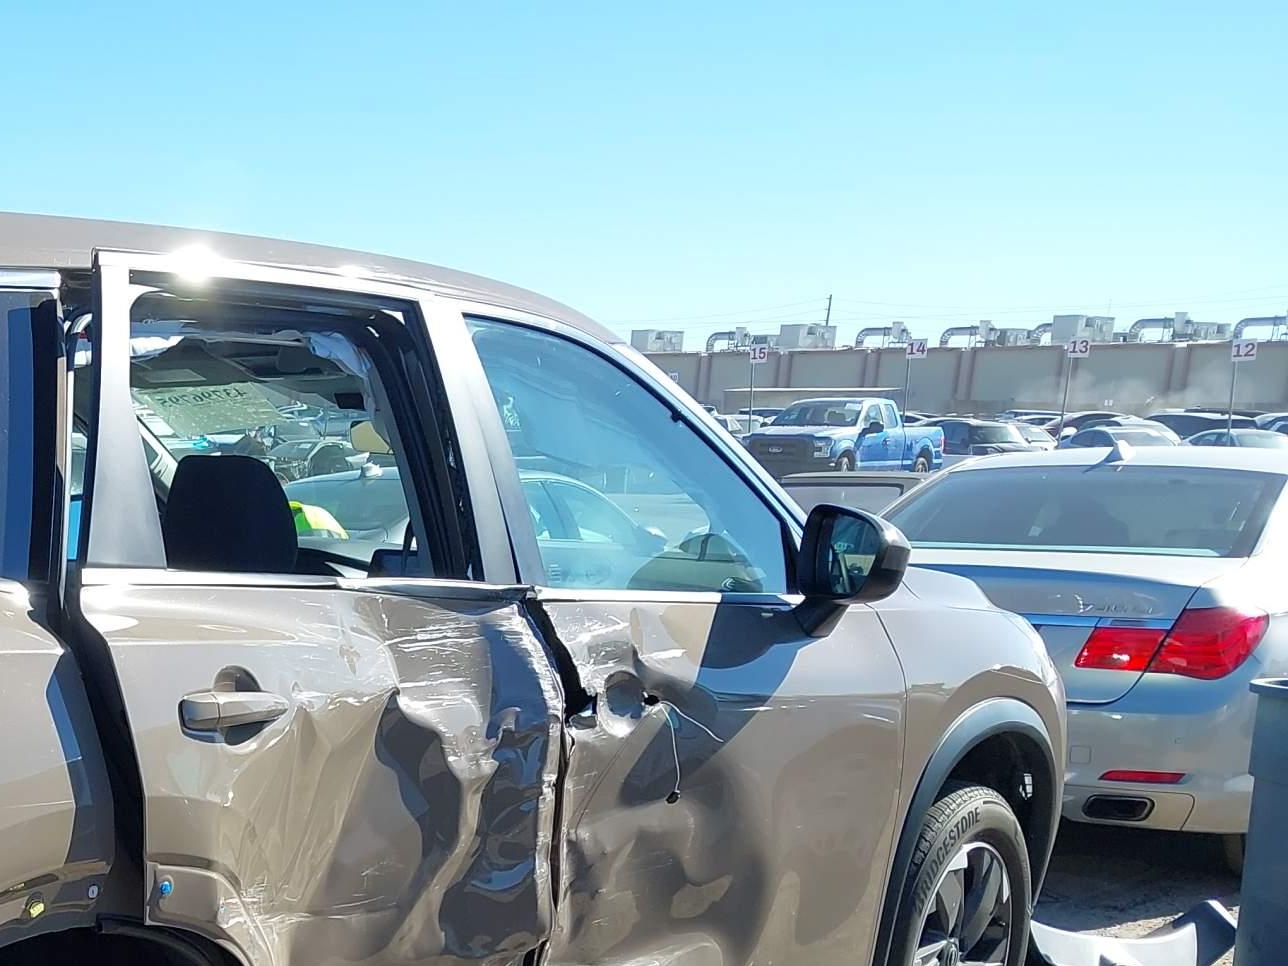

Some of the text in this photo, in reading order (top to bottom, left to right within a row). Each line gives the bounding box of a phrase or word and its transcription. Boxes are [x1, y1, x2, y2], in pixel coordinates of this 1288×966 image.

[751, 347, 766, 360] 15
[907, 342, 926, 355] 14
[1069, 340, 1089, 354] 13
[1233, 343, 1256, 358] 12
